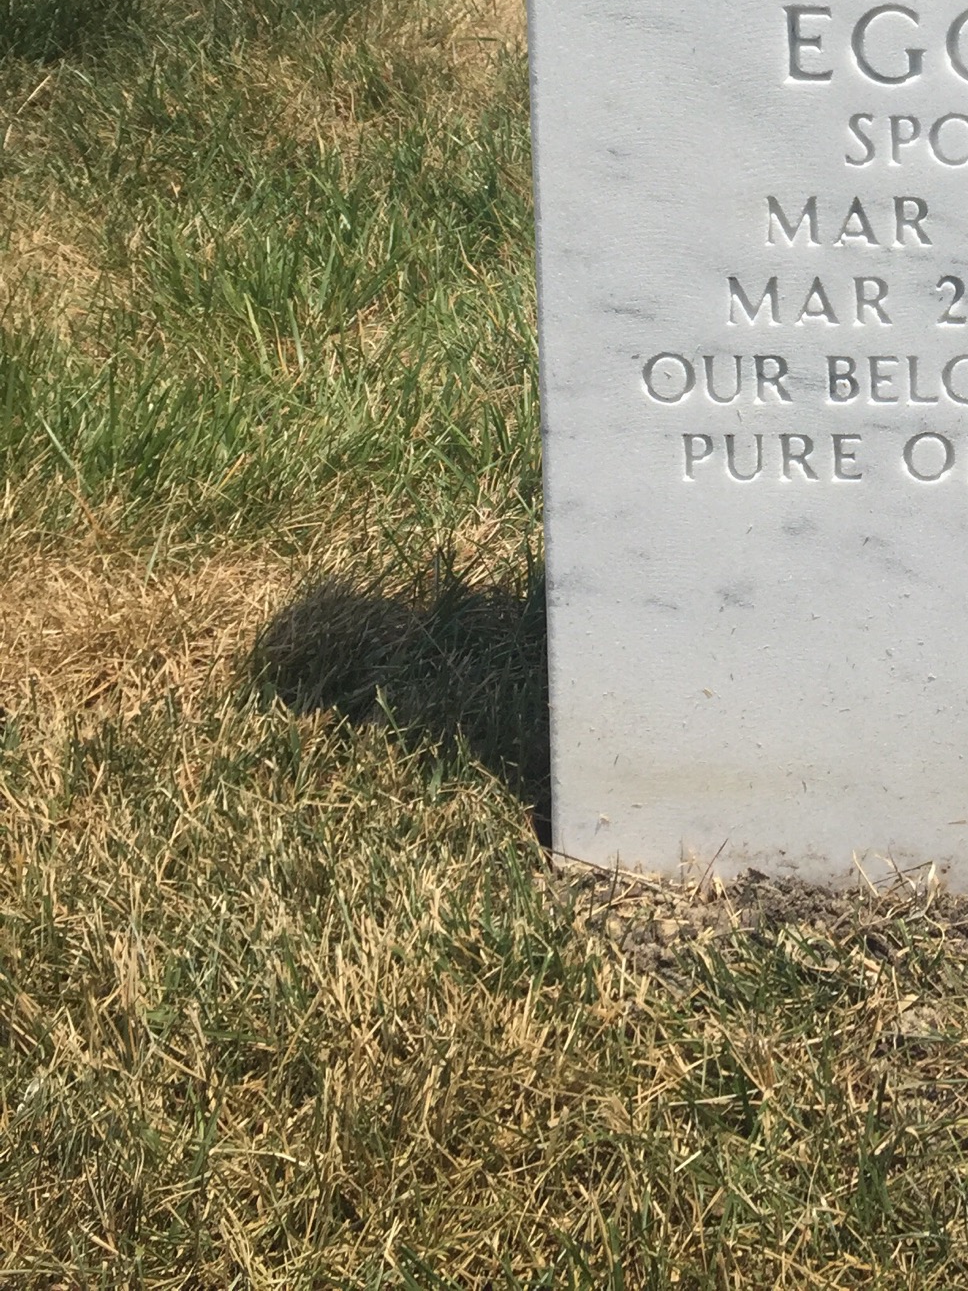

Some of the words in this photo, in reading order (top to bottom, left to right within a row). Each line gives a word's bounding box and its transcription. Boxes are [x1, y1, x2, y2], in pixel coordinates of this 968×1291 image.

[763, 195, 933, 249] MAR
[725, 275, 893, 328] MAR
[641, 351, 794, 405] OUR
[680, 431, 864, 483] PURE
